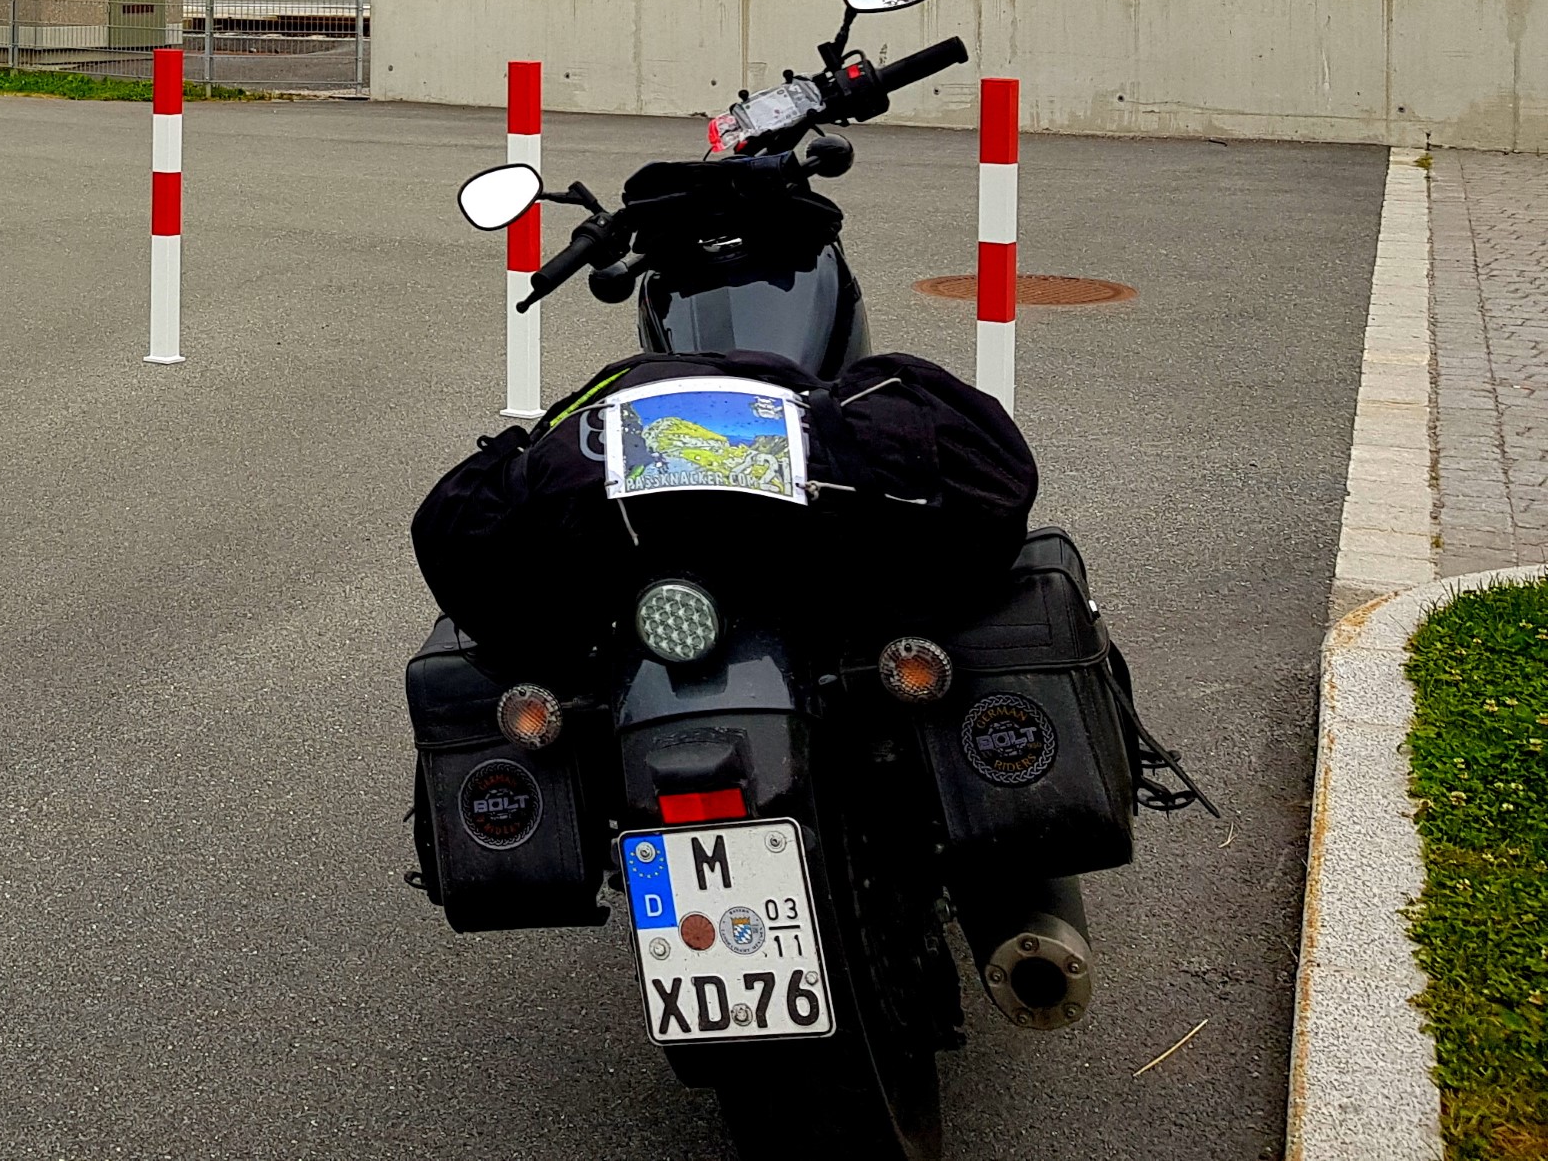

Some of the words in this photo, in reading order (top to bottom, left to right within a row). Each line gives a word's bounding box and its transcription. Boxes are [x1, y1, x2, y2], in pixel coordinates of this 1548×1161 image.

[976, 727, 1038, 751] BOLT
[994, 753, 1037, 771] RIDERS
[473, 795, 529, 813] BOLT
[691, 834, 732, 890] M
[645, 894, 663, 917] D
[764, 897, 798, 921] 03
[774, 934, 802, 958] 11
[652, 975, 731, 1035] XD
[743, 969, 820, 1029] 76
